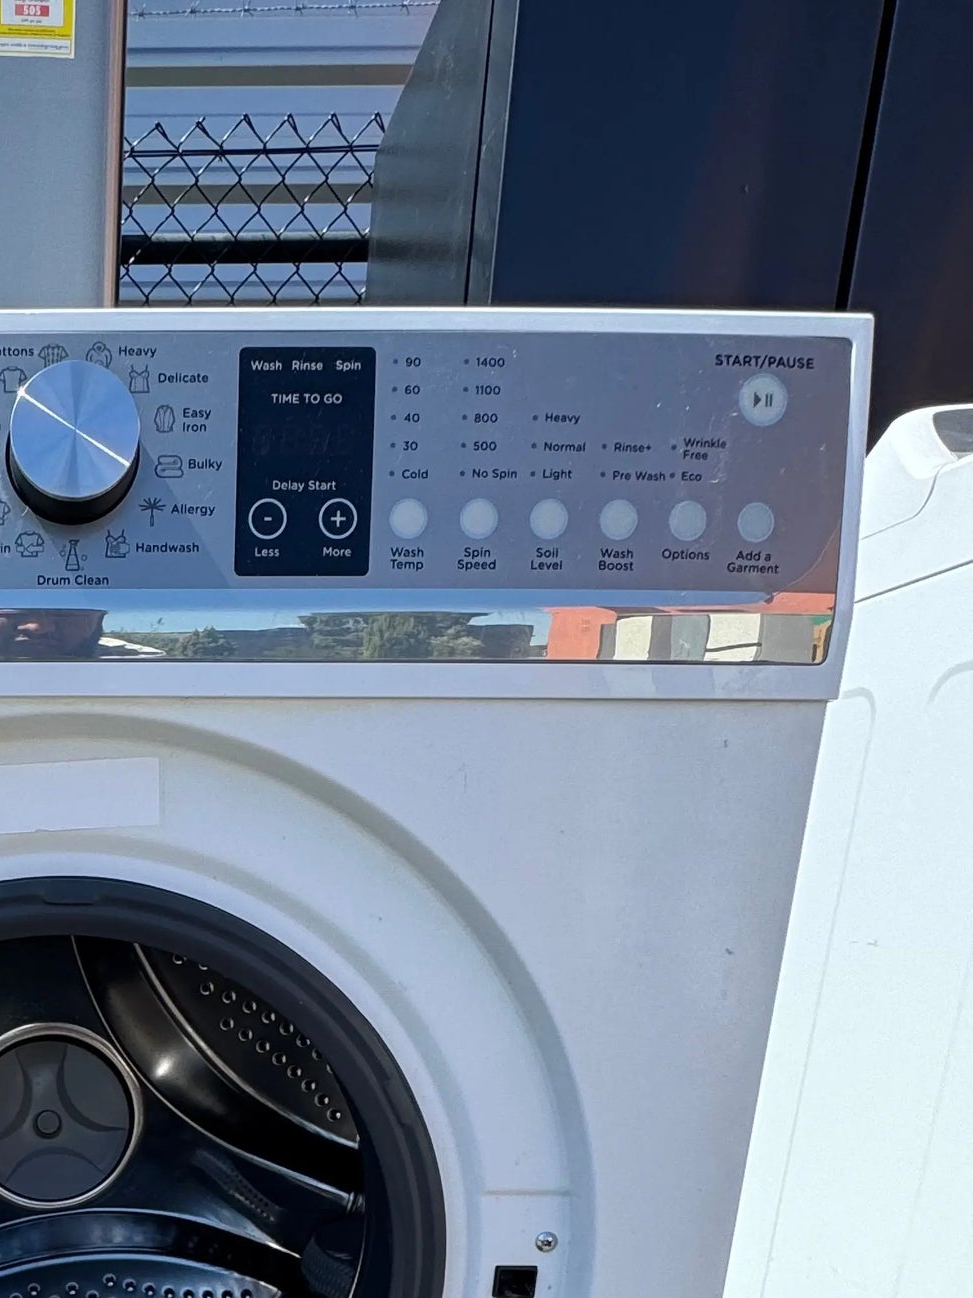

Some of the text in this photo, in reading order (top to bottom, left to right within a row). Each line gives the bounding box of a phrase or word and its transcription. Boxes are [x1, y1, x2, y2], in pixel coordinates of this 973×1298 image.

[118, 346, 157, 358] Heavy
[251, 360, 362, 373] Wash Rinse Spin
[405, 357, 421, 367] 90
[476, 357, 505, 368] 1400
[715, 354, 814, 370] START/PAUSE
[158, 372, 209, 384] Delicate
[404, 385, 421, 395] 60
[475, 385, 501, 395] 1100
[271, 393, 343, 404] TIME TO GO
[182, 408, 211, 420] Easy
[404, 413, 420, 423] 40
[474, 413, 498, 423] 800
[545, 412, 581, 425] Heavy
[182, 421, 207, 432] Iron
[402, 441, 418, 451] 30
[473, 441, 497, 451] 500
[543, 441, 586, 452] Normal
[683, 437, 727, 449] Wrinkle
[683, 450, 708, 461] Free
[188, 459, 223, 471] Bulky
[402, 469, 428, 479] Cold
[472, 469, 517, 480] No Spin
[542, 469, 572, 480] Light
[612, 470, 665, 481] Pre Wash
[681, 471, 702, 482] Eco
[272, 480, 336, 492] Delay Start
[170, 504, 216, 516] Allergy
[135, 542, 200, 553] Handwash
[254, 547, 280, 557] Less
[323, 547, 352, 557] More
[390, 547, 424, 558] Wash
[536, 547, 559, 558] Soil
[463, 547, 491, 560] Spin
[600, 548, 634, 559] Wash
[662, 548, 710, 561] Options
[735, 550, 772, 562] Add a
[390, 559, 424, 571] Temp
[457, 559, 497, 571] Speed
[530, 560, 563, 571] Level
[598, 560, 634, 571] Boost
[727, 562, 779, 574] Garment
[37, 575, 109, 586] Drum Clean
